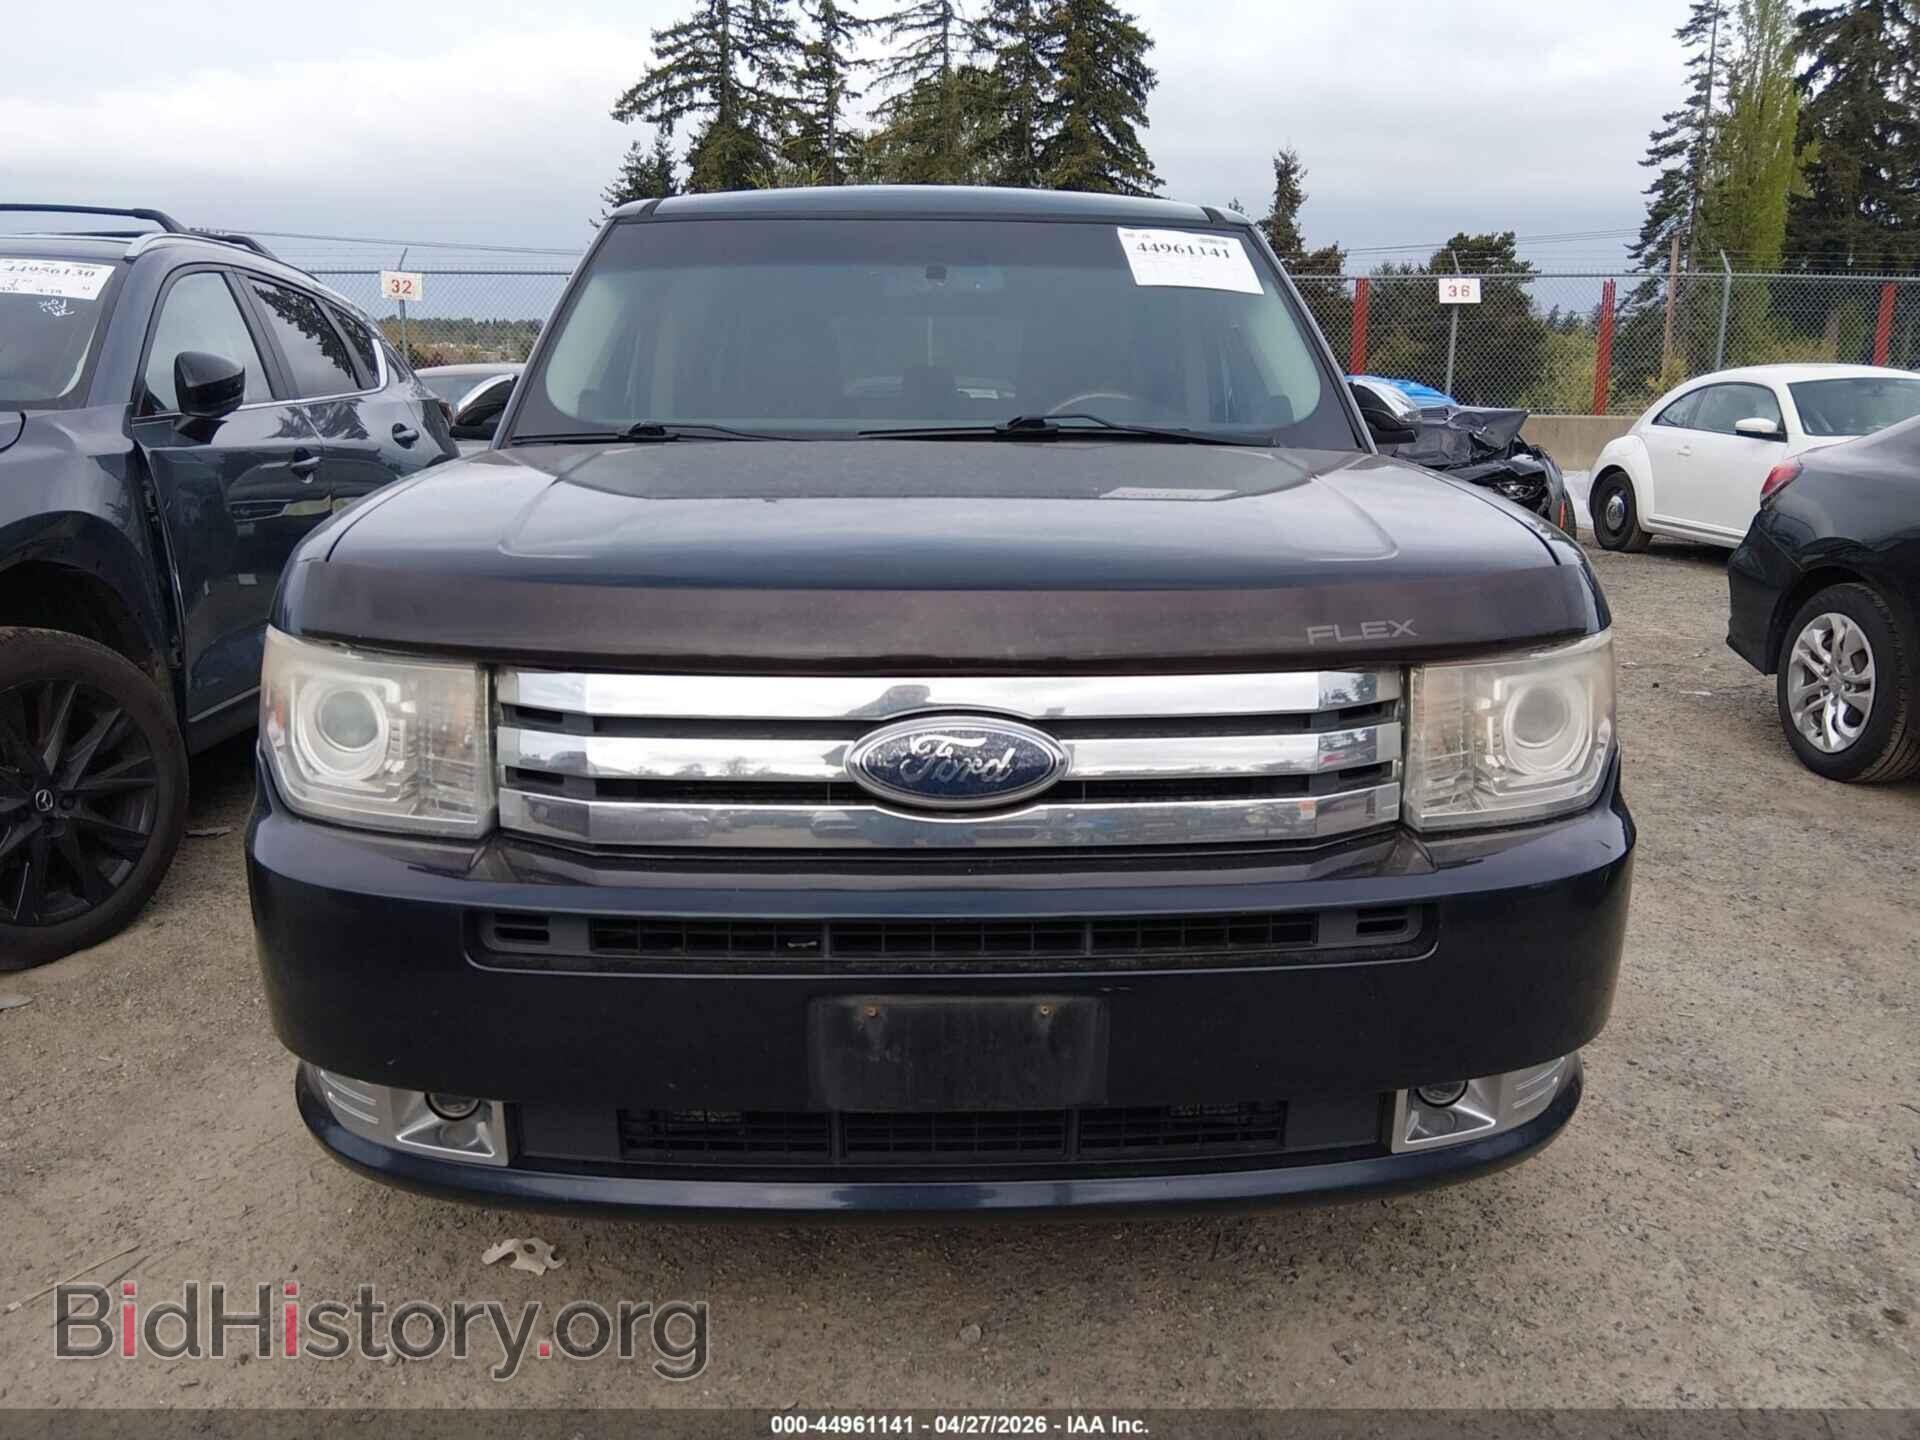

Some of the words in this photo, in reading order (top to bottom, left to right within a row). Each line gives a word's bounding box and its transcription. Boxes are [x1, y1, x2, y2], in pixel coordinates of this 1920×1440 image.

[1137, 242, 1230, 259] 44961141
[391, 279, 412, 294] 32
[1448, 284, 1470, 297] 36
[1306, 619, 1417, 645] FLEX
[901, 735, 1016, 783] Ford
